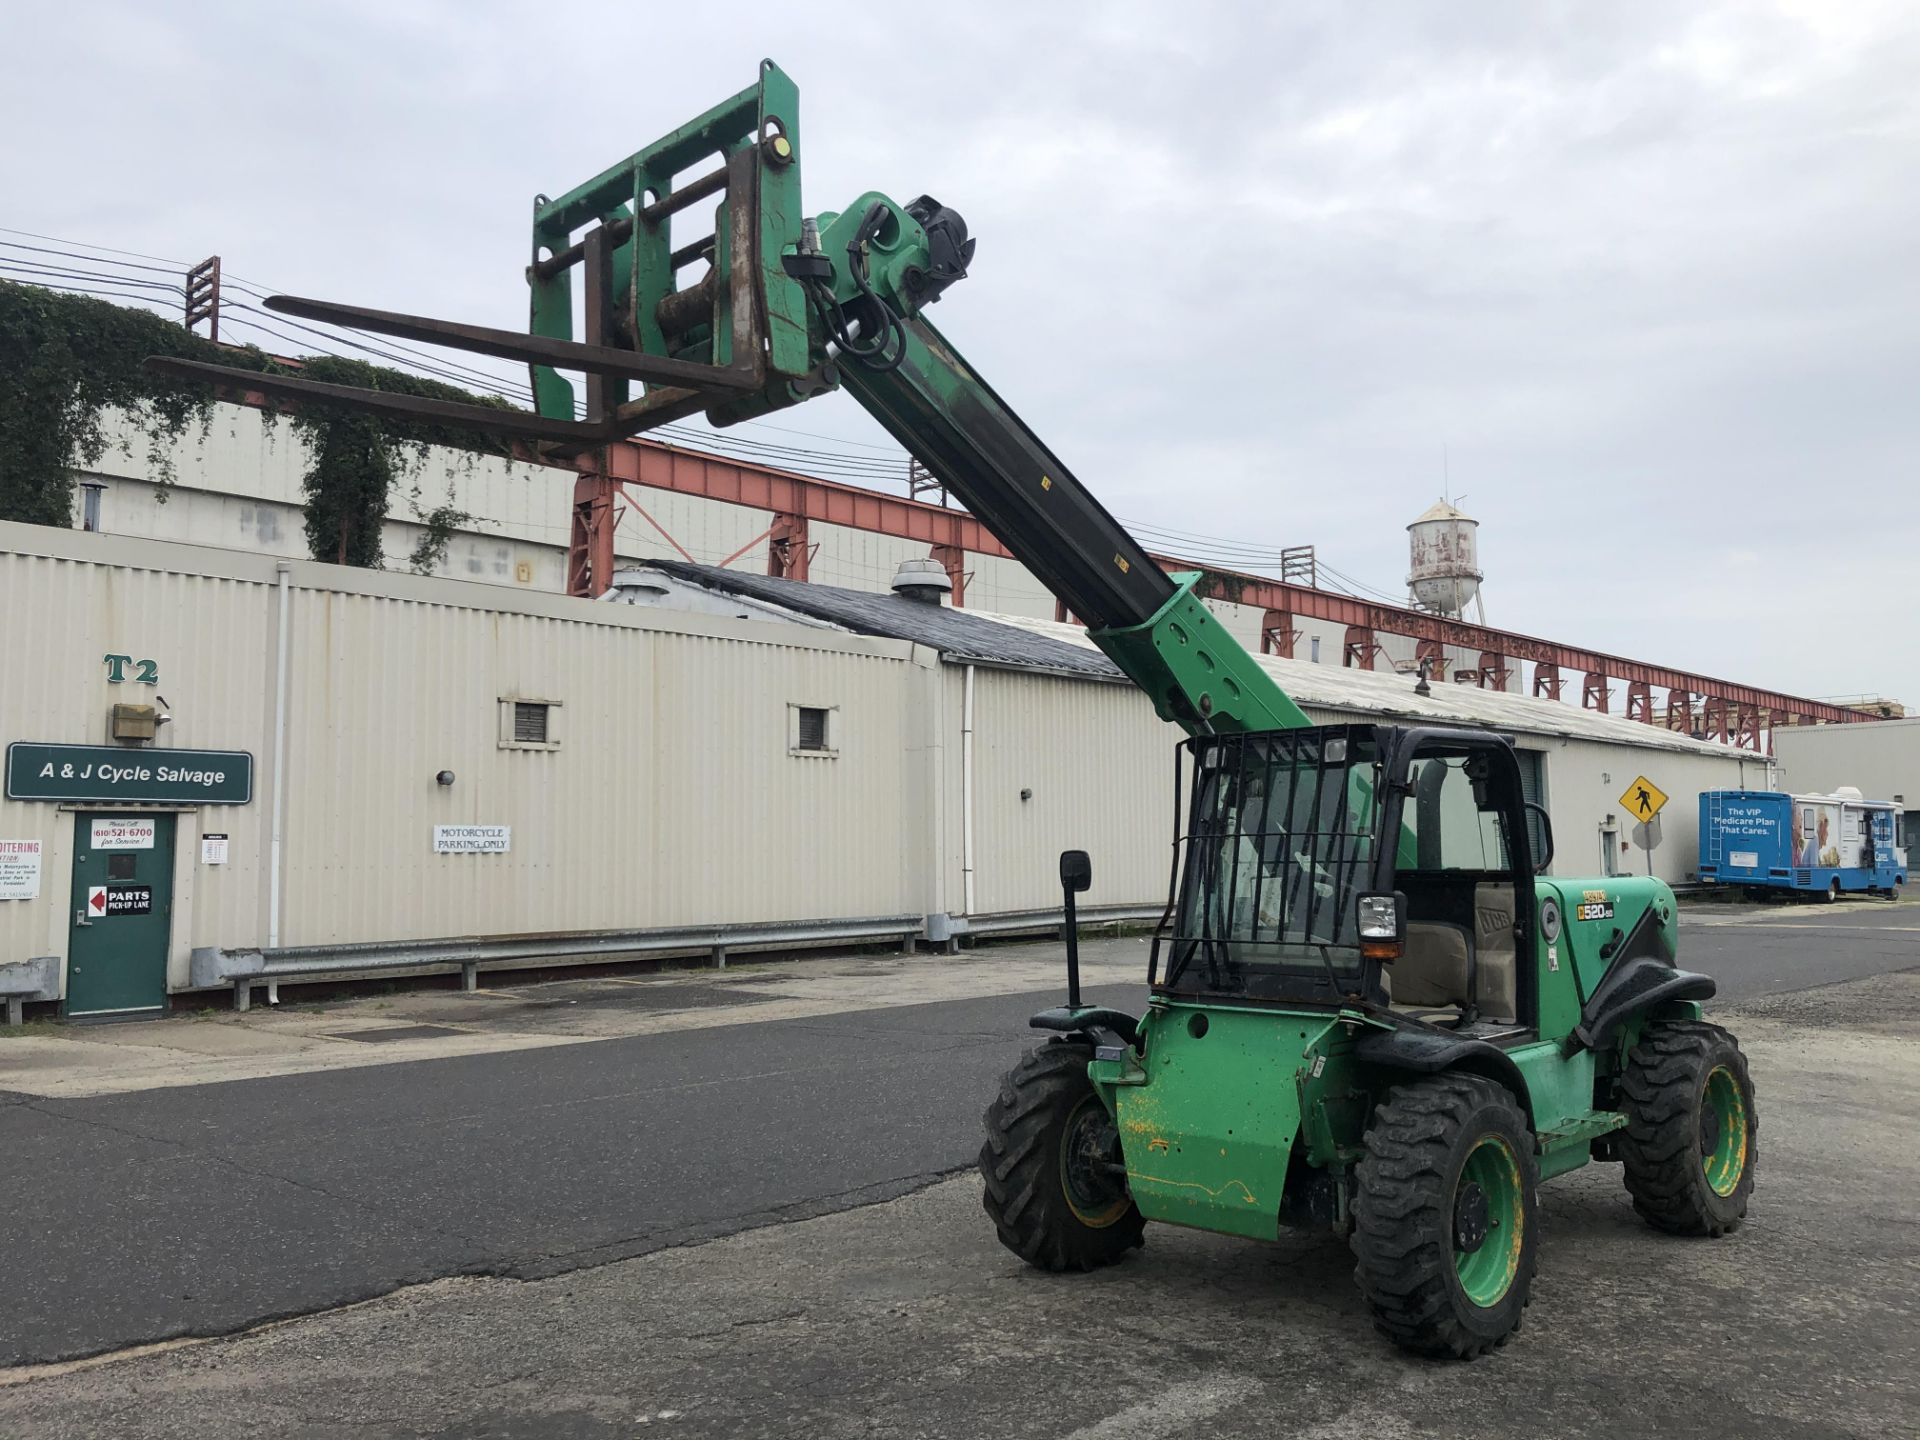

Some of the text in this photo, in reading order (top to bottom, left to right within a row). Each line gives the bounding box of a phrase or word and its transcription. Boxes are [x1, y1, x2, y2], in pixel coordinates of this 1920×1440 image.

[103, 653, 159, 684] T2
[39, 762, 225, 786] A & J Cycle Salvage
[1728, 808, 1762, 816] The VIP
[1714, 817, 1775, 826] Medicare Plan
[441, 828, 504, 838] MOTORCYCLE
[1720, 826, 1770, 835] That Cares.
[438, 840, 507, 849] PARKING ONLY
[108, 891, 150, 901] PARTS
[108, 900, 150, 909] PICK-UP LANE
